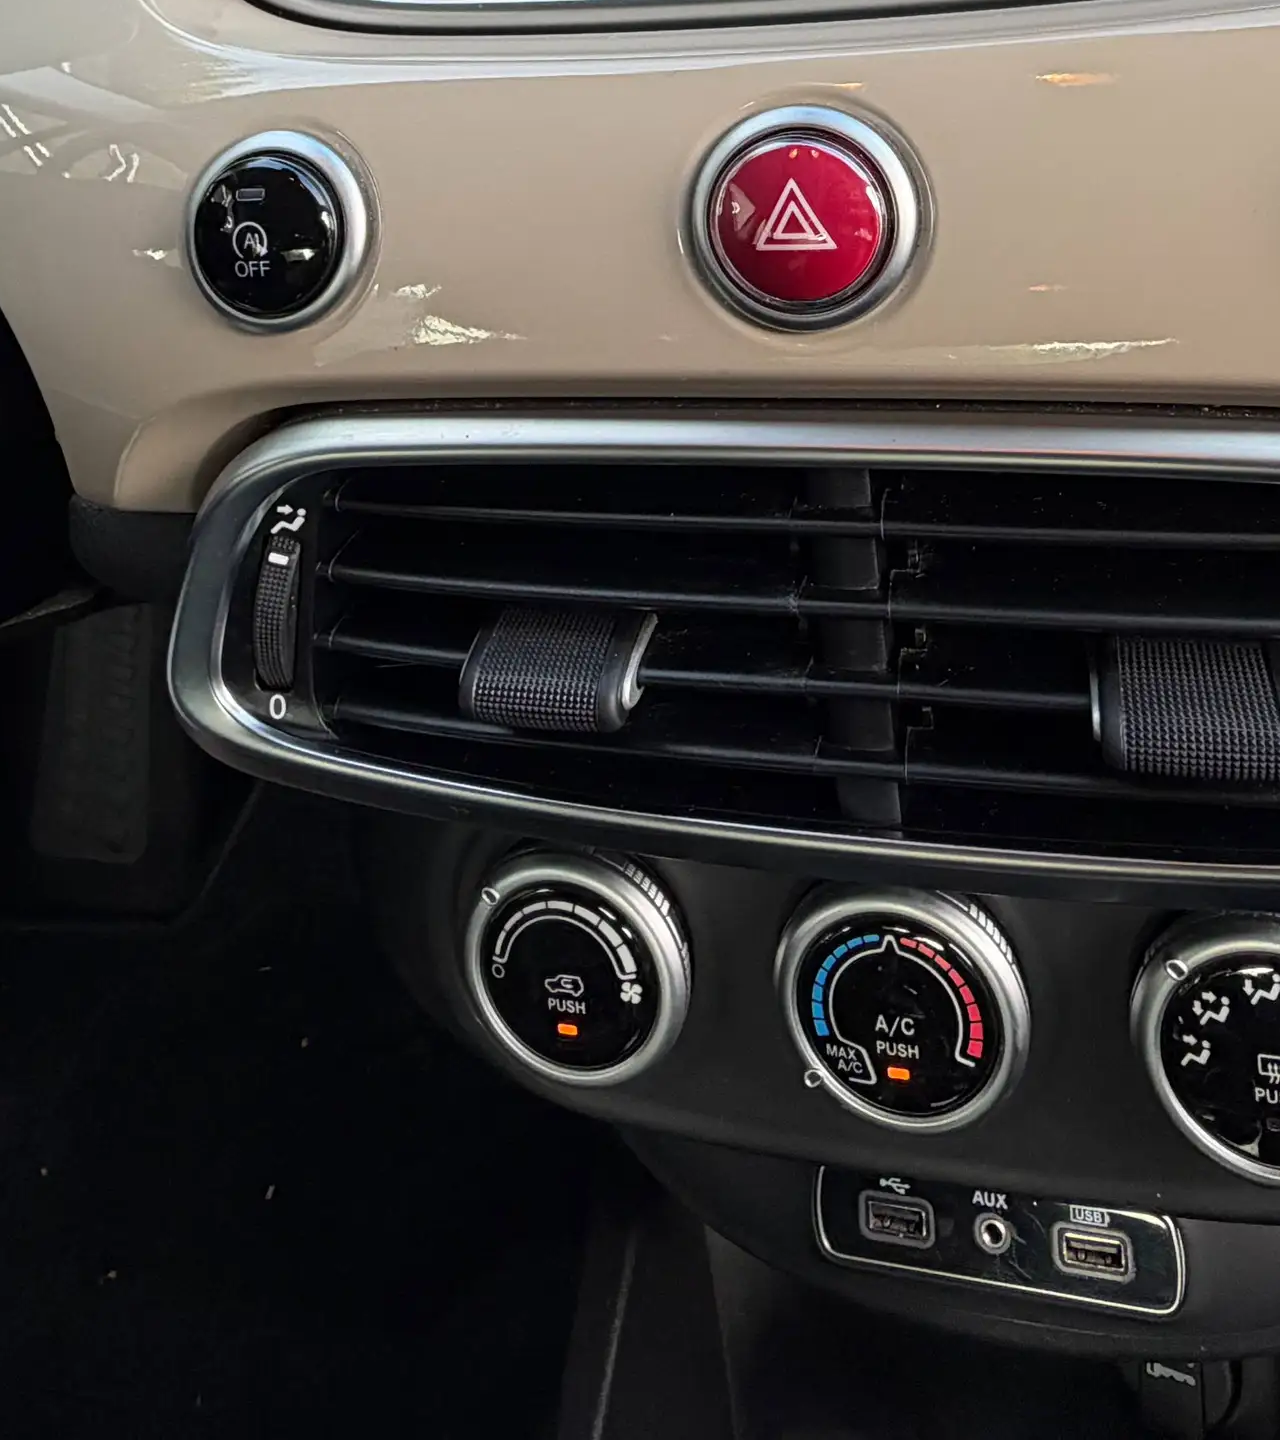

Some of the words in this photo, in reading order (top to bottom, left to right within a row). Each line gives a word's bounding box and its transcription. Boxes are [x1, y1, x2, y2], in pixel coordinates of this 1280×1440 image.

[235, 261, 270, 277] OFF
[548, 998, 586, 1014] PUSH
[875, 1015, 915, 1037] A/C
[826, 1043, 857, 1060] MAX
[876, 1040, 919, 1059] PUSH
[837, 1059, 863, 1074] A/C
[972, 1190, 1008, 1210] AUX
[1075, 1207, 1102, 1223] USB
